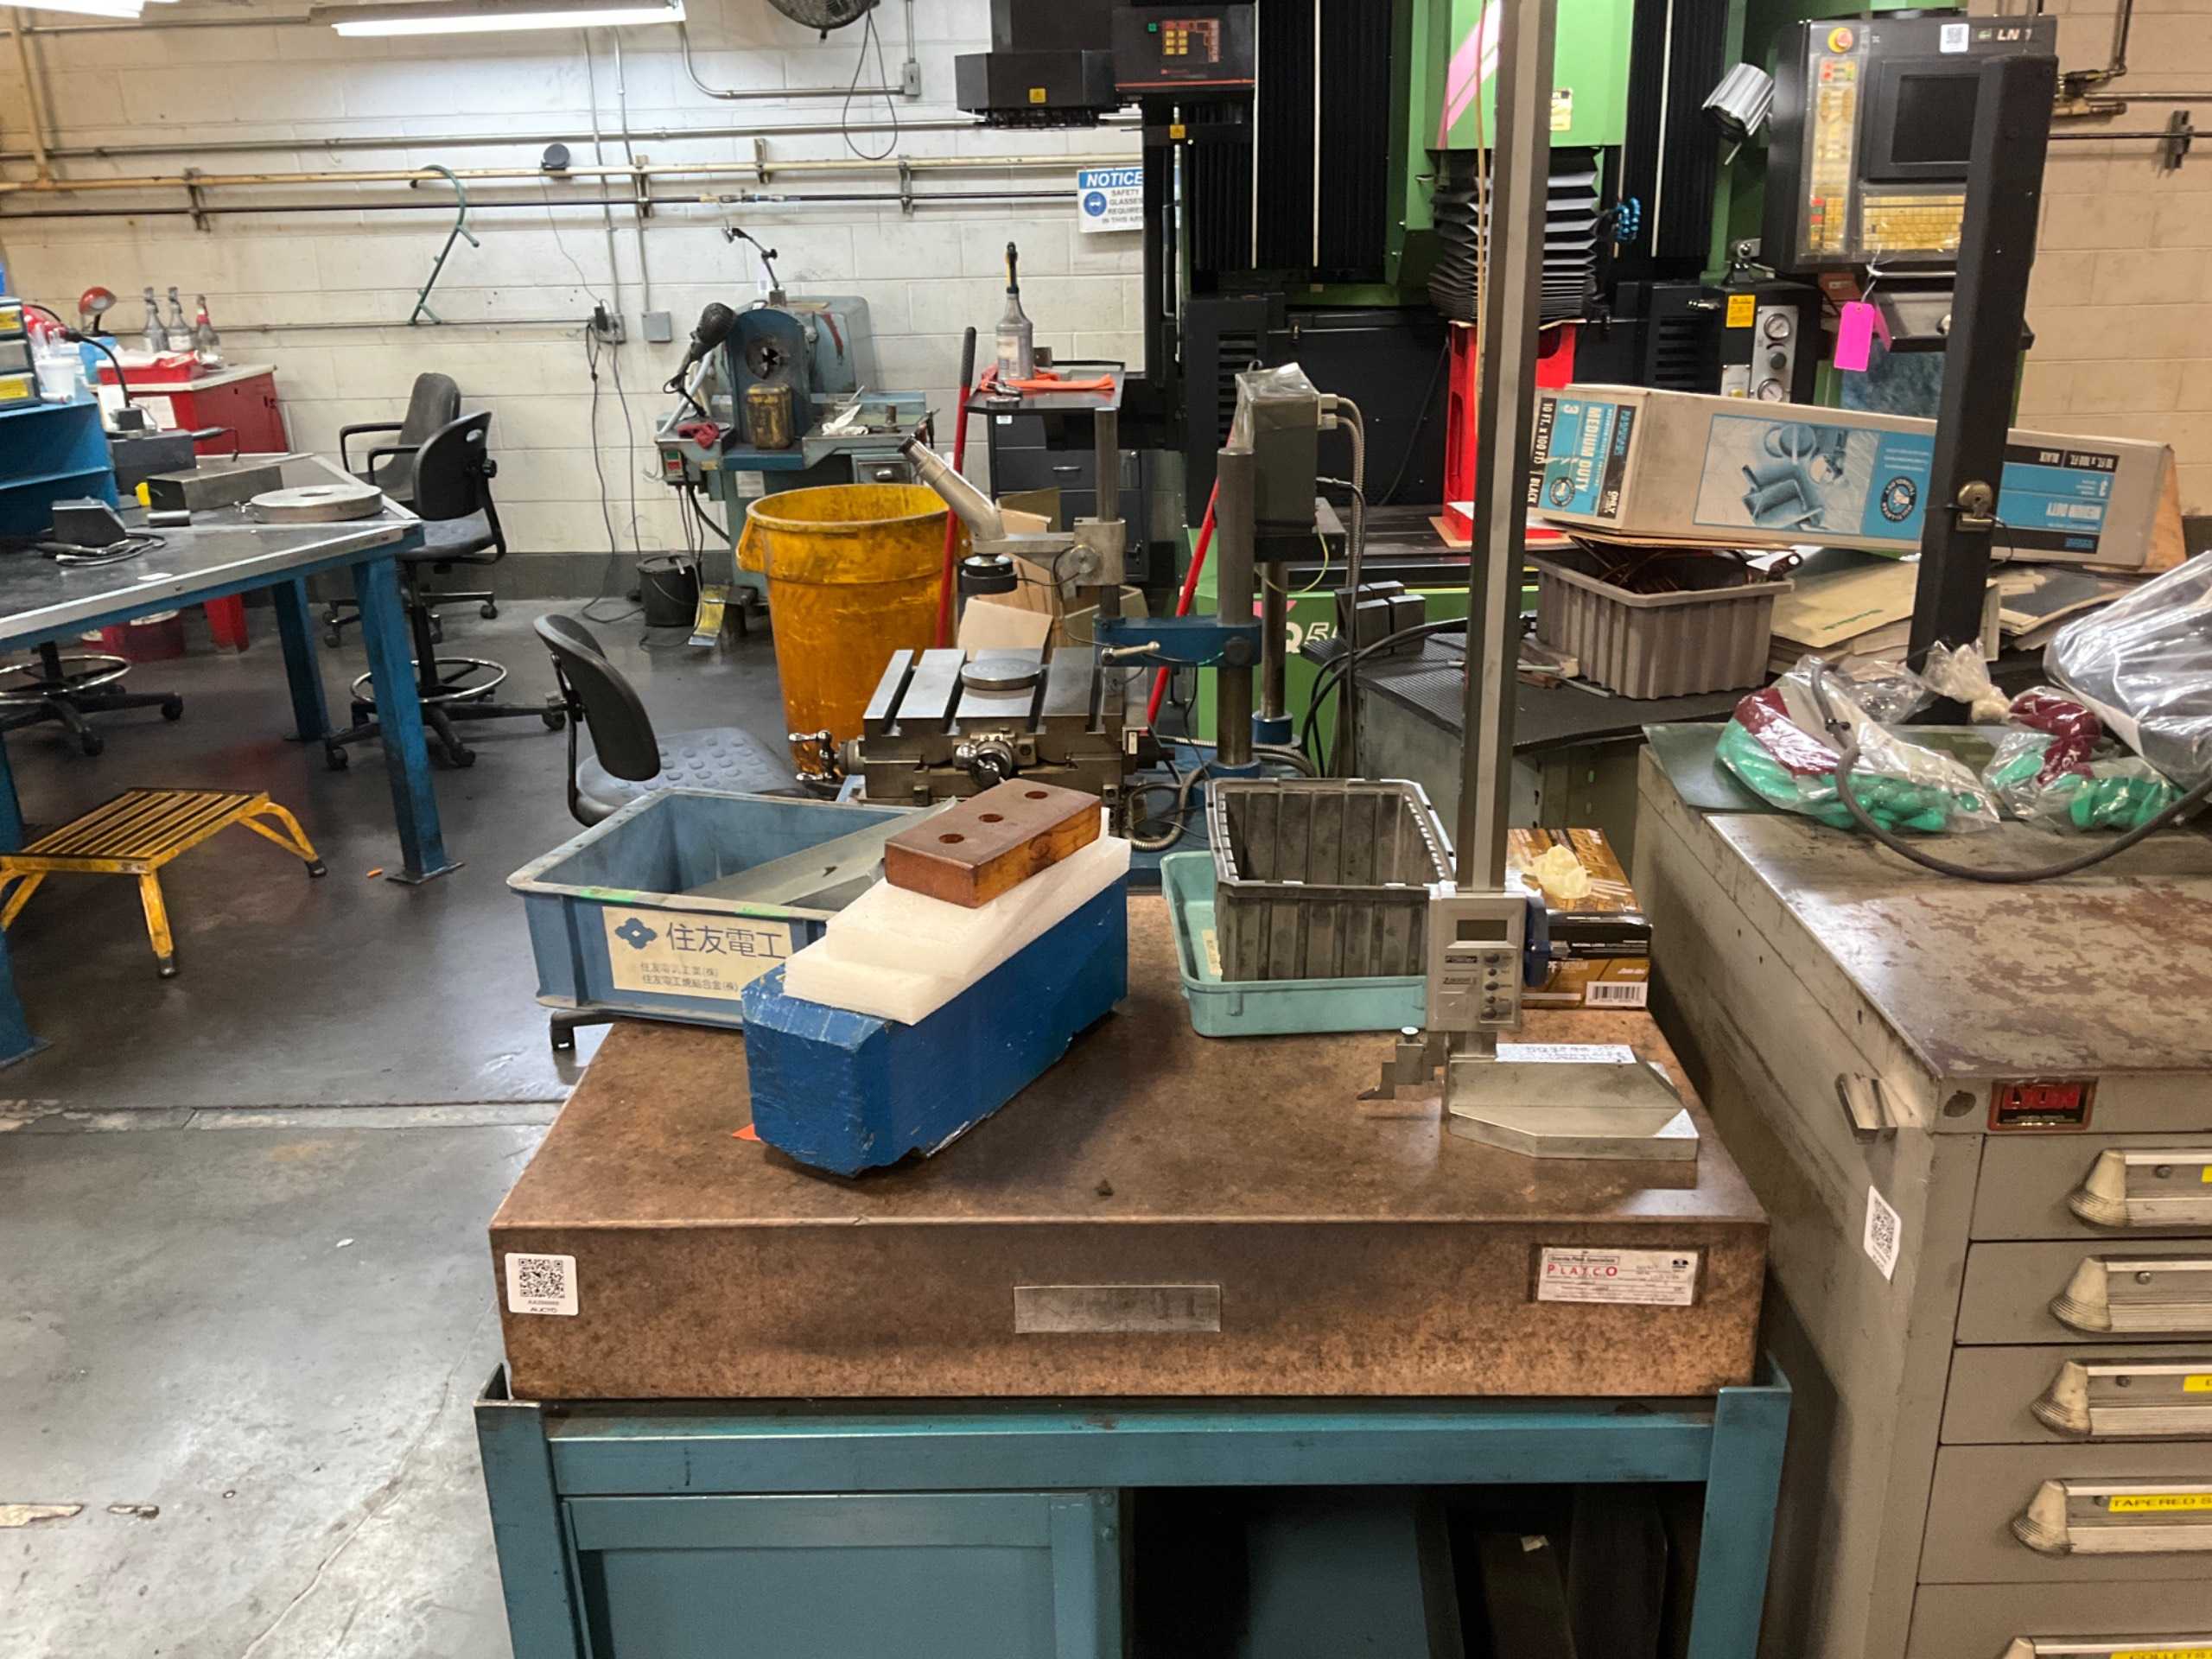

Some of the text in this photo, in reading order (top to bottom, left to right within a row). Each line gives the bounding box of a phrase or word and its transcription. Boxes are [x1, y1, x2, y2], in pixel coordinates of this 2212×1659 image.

[1086, 171, 1143, 188] NOTICE
[1541, 403, 1554, 412] 10
[1535, 435, 1548, 449] 100
[1574, 406, 1603, 493] MEDIUM DUTY
[1527, 477, 1541, 504] BLACK
[666, 921, 787, 960] 住友電工
[2114, 1498, 2196, 1508] TAPERED
